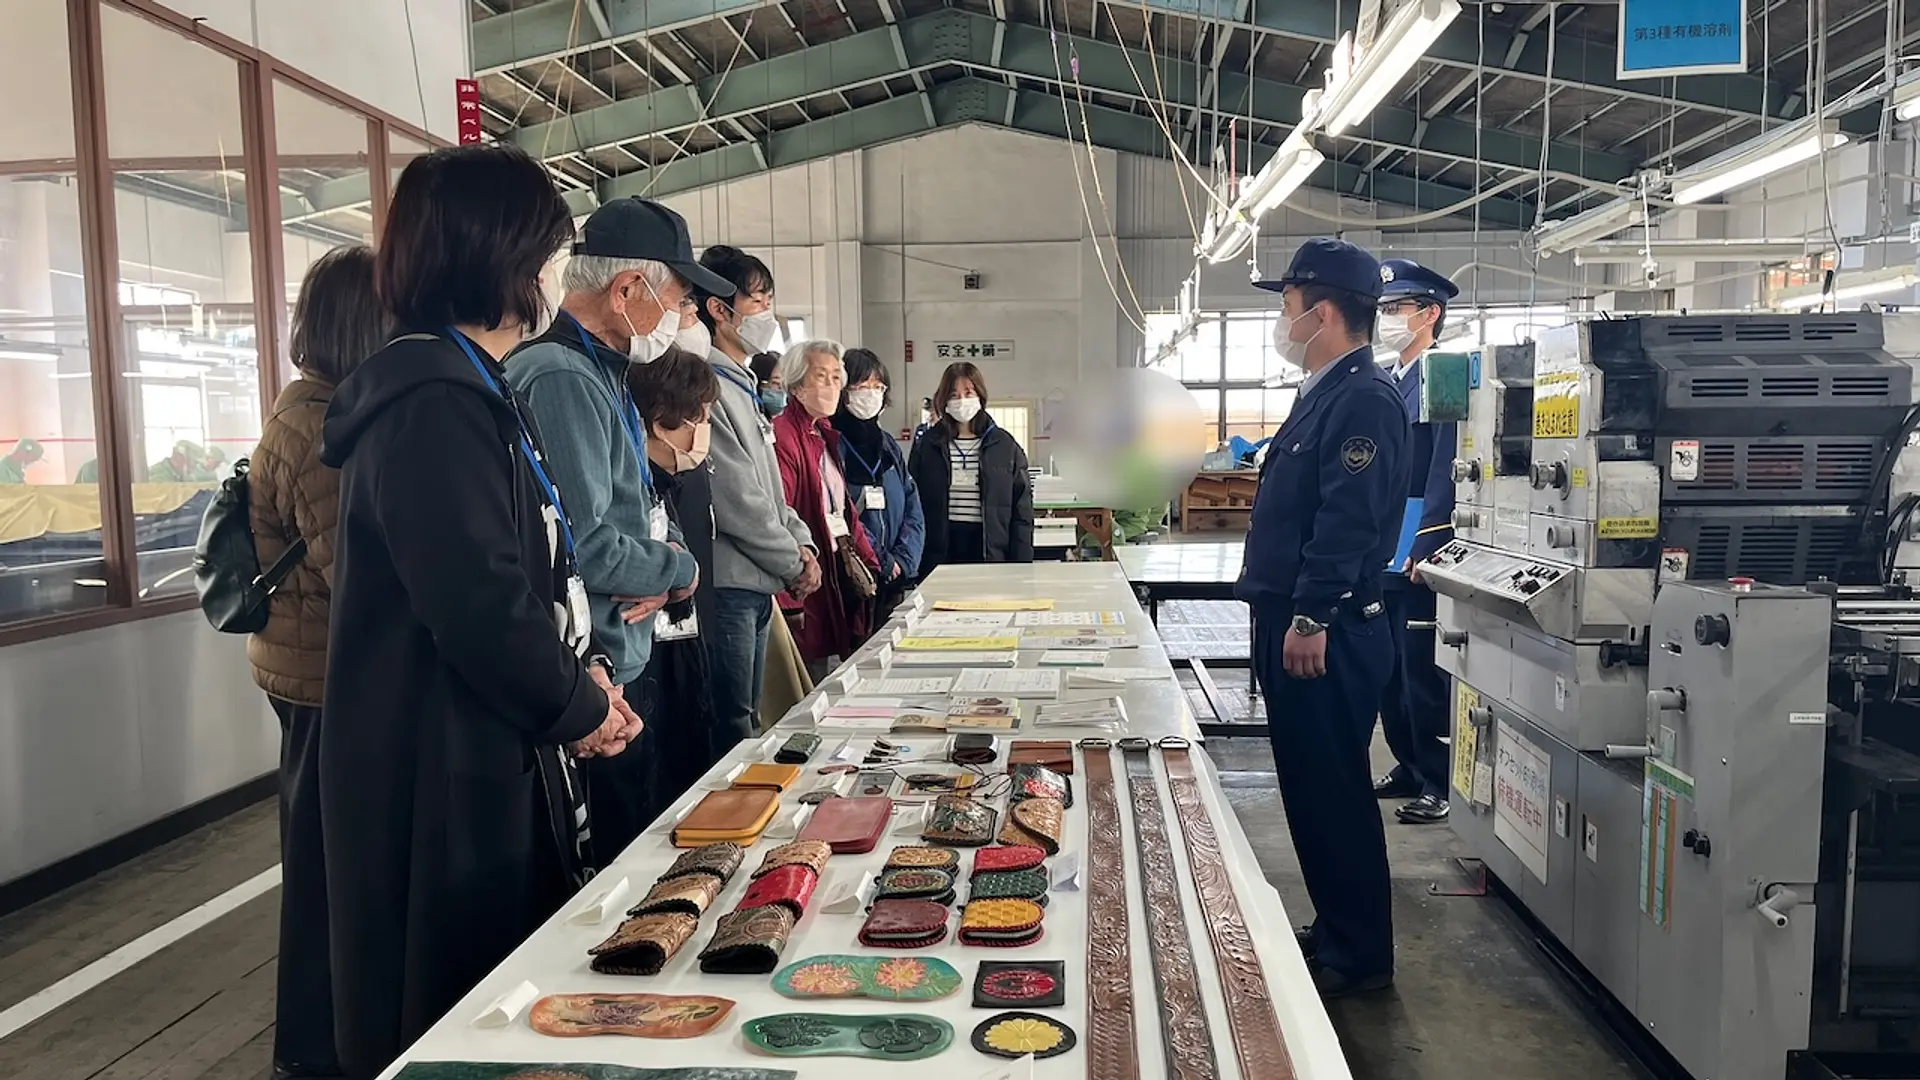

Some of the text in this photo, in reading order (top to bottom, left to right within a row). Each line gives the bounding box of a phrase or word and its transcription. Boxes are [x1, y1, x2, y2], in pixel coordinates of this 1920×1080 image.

[1634, 22, 1731, 41] 第3種有機溶剤
[460, 84, 478, 141] 非常ベル
